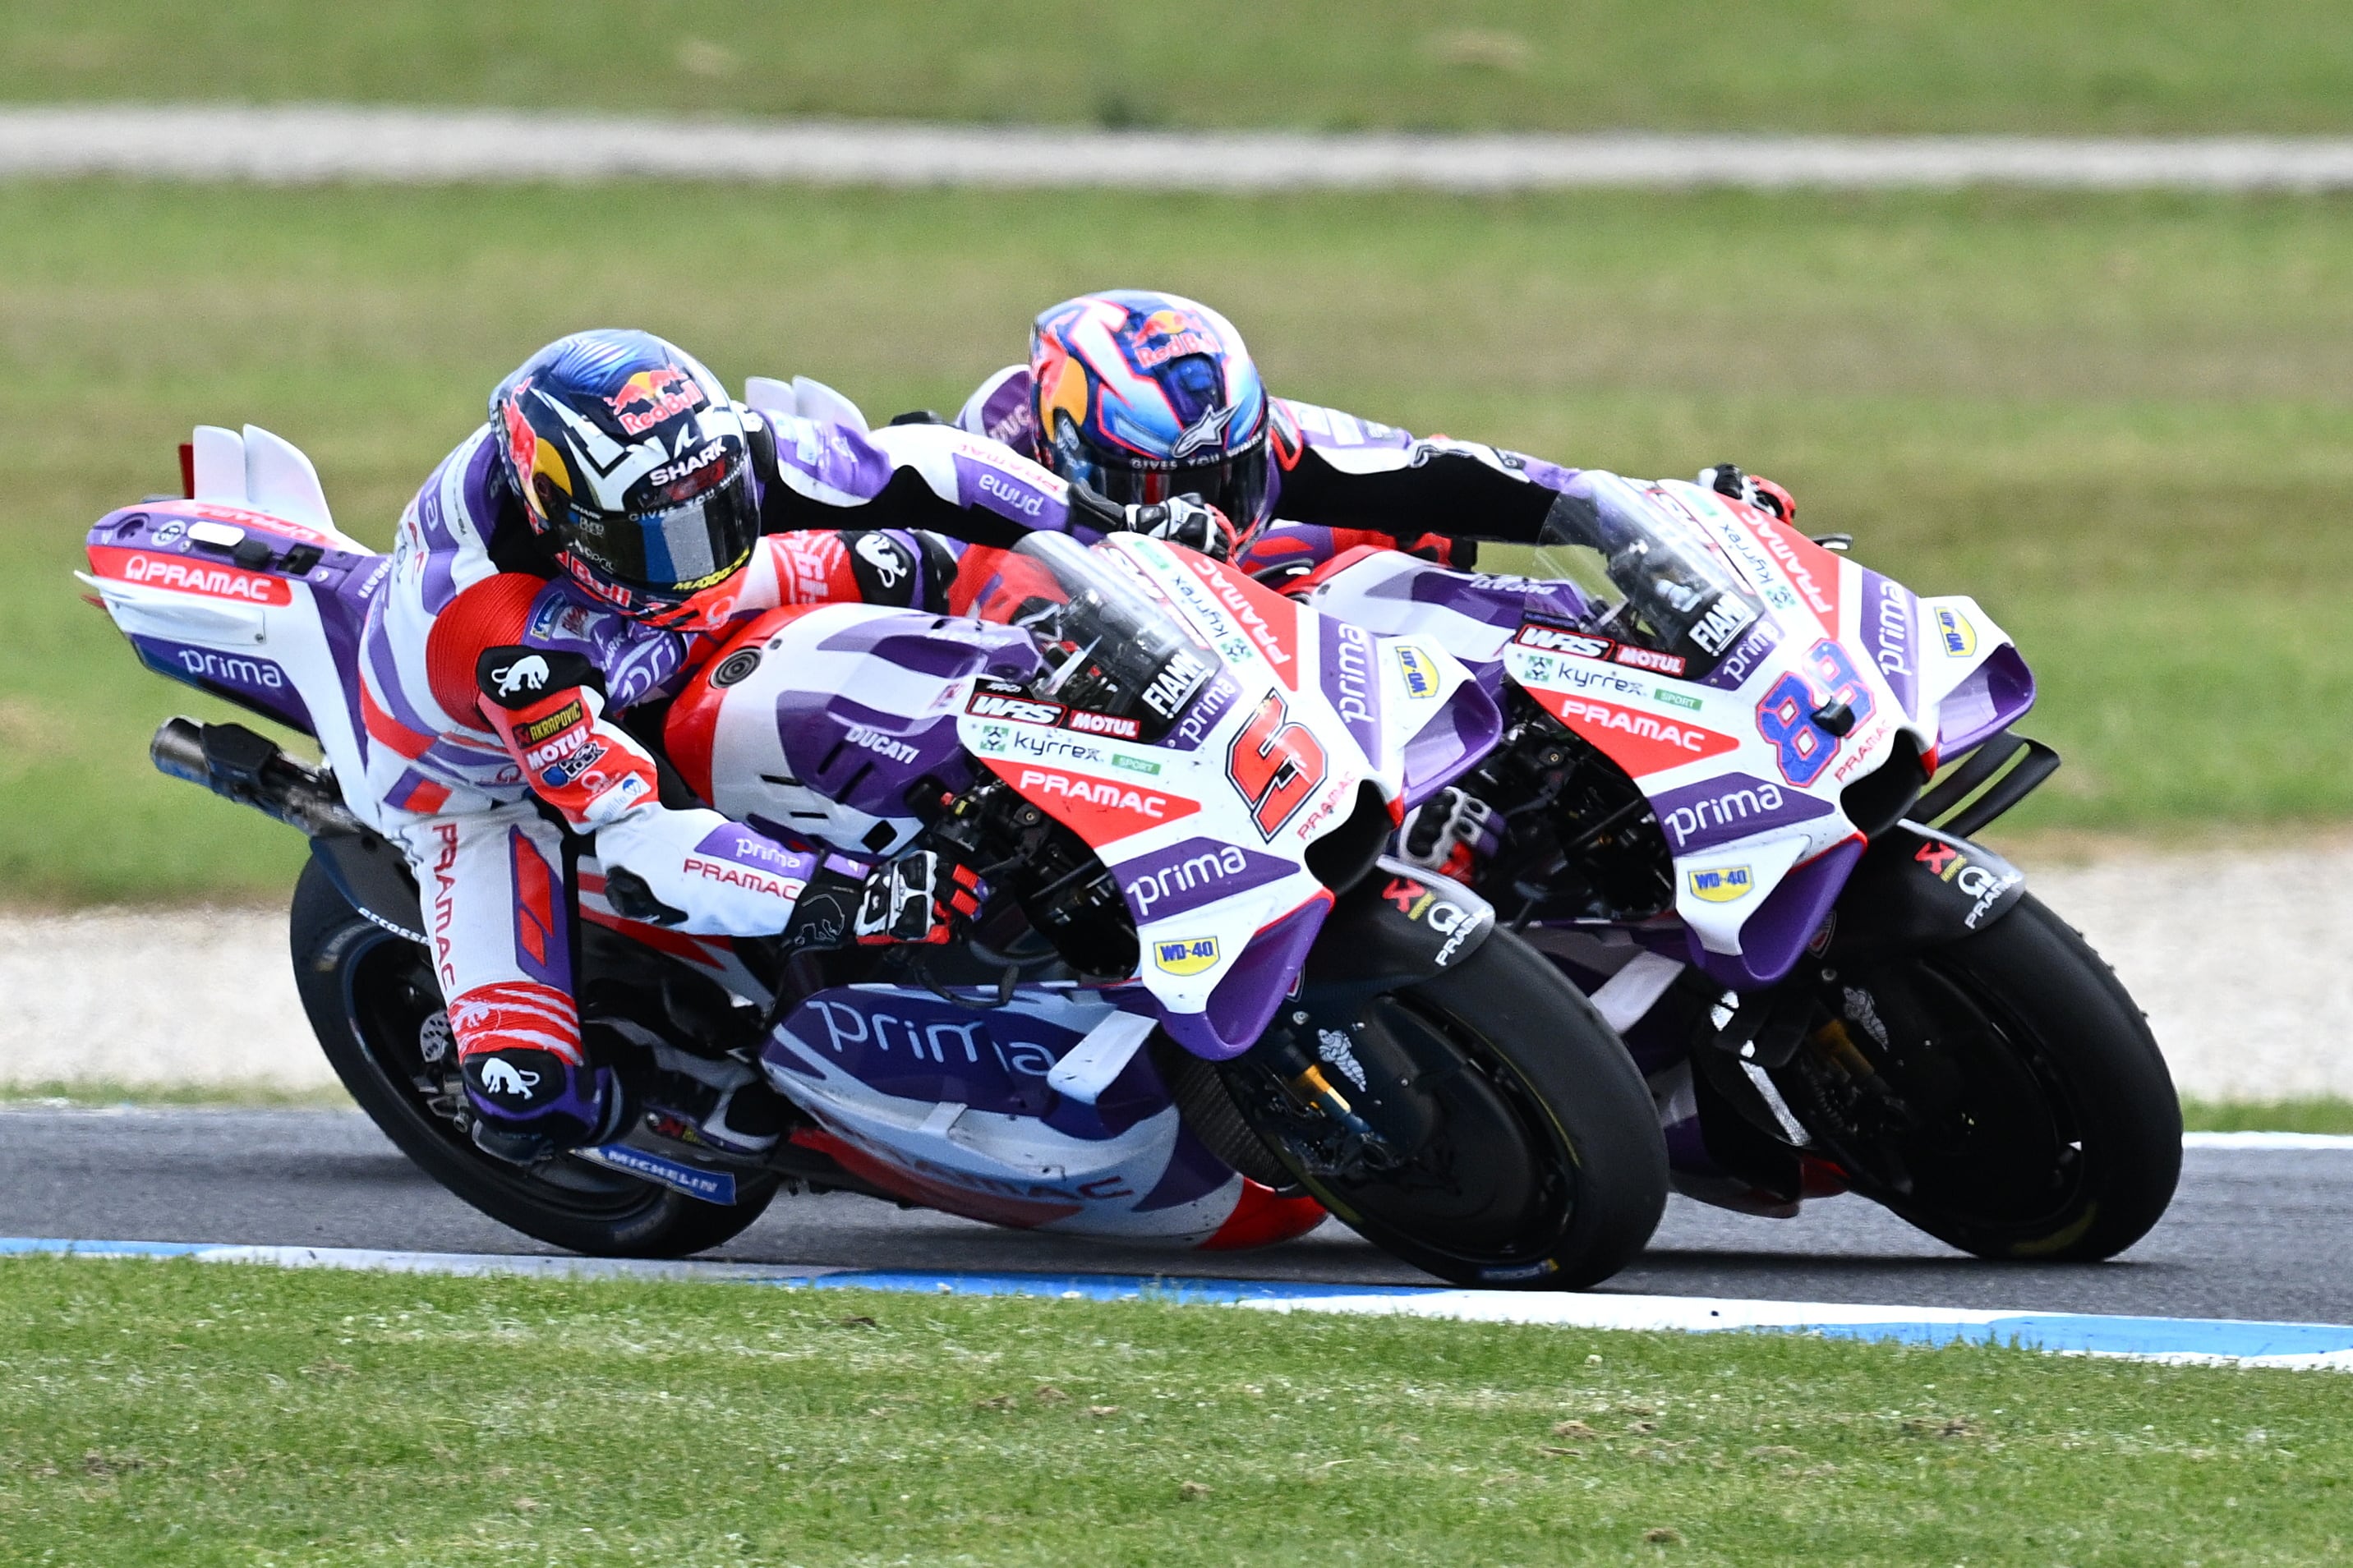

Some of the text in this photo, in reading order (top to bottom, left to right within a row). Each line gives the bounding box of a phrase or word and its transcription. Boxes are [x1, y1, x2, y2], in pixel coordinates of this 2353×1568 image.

[1136, 334, 1184, 370] Red
[619, 380, 703, 435] Red Bull
[649, 437, 727, 486] SHARK
[629, 507, 678, 522] GIVES
[978, 473, 1044, 518] prima
[145, 563, 273, 601] PRAMAC
[571, 556, 633, 608] Bull
[1741, 508, 1834, 613] PRAMAC
[1172, 575, 1229, 637] kyrrex
[1193, 558, 1292, 664] PRAMAC
[1878, 581, 1913, 676] prima
[1521, 628, 1609, 657] WRS
[1619, 646, 1683, 673] MOTUL
[179, 650, 282, 687] prima
[1338, 623, 1375, 724] prima
[1559, 662, 1644, 696] kyrrex
[971, 695, 1061, 724] WRS
[1179, 678, 1236, 743] prima
[1660, 692, 1695, 708] SPORT
[1755, 637, 1876, 788] 89
[845, 725, 920, 765] DUCATI
[1014, 731, 1101, 762] kyrrex
[1071, 712, 1136, 737] MOTUL
[1562, 700, 1706, 753] PRAMAC
[527, 726, 589, 770] MOTUL
[1225, 687, 1328, 844] 5
[1020, 770, 1167, 819] PRAMAC
[1296, 770, 1356, 841] PRAMAC
[1664, 784, 1783, 847] prima
[735, 838, 801, 869] prima
[684, 858, 802, 901] PRAMAC
[1126, 845, 1246, 917] prima
[1695, 868, 1748, 890] WD-40
[432, 822, 458, 991] PRAMAC
[1160, 940, 1214, 962] WD-40
[806, 1000, 1056, 1077] prima
[608, 1150, 719, 1193] MICHELIN
